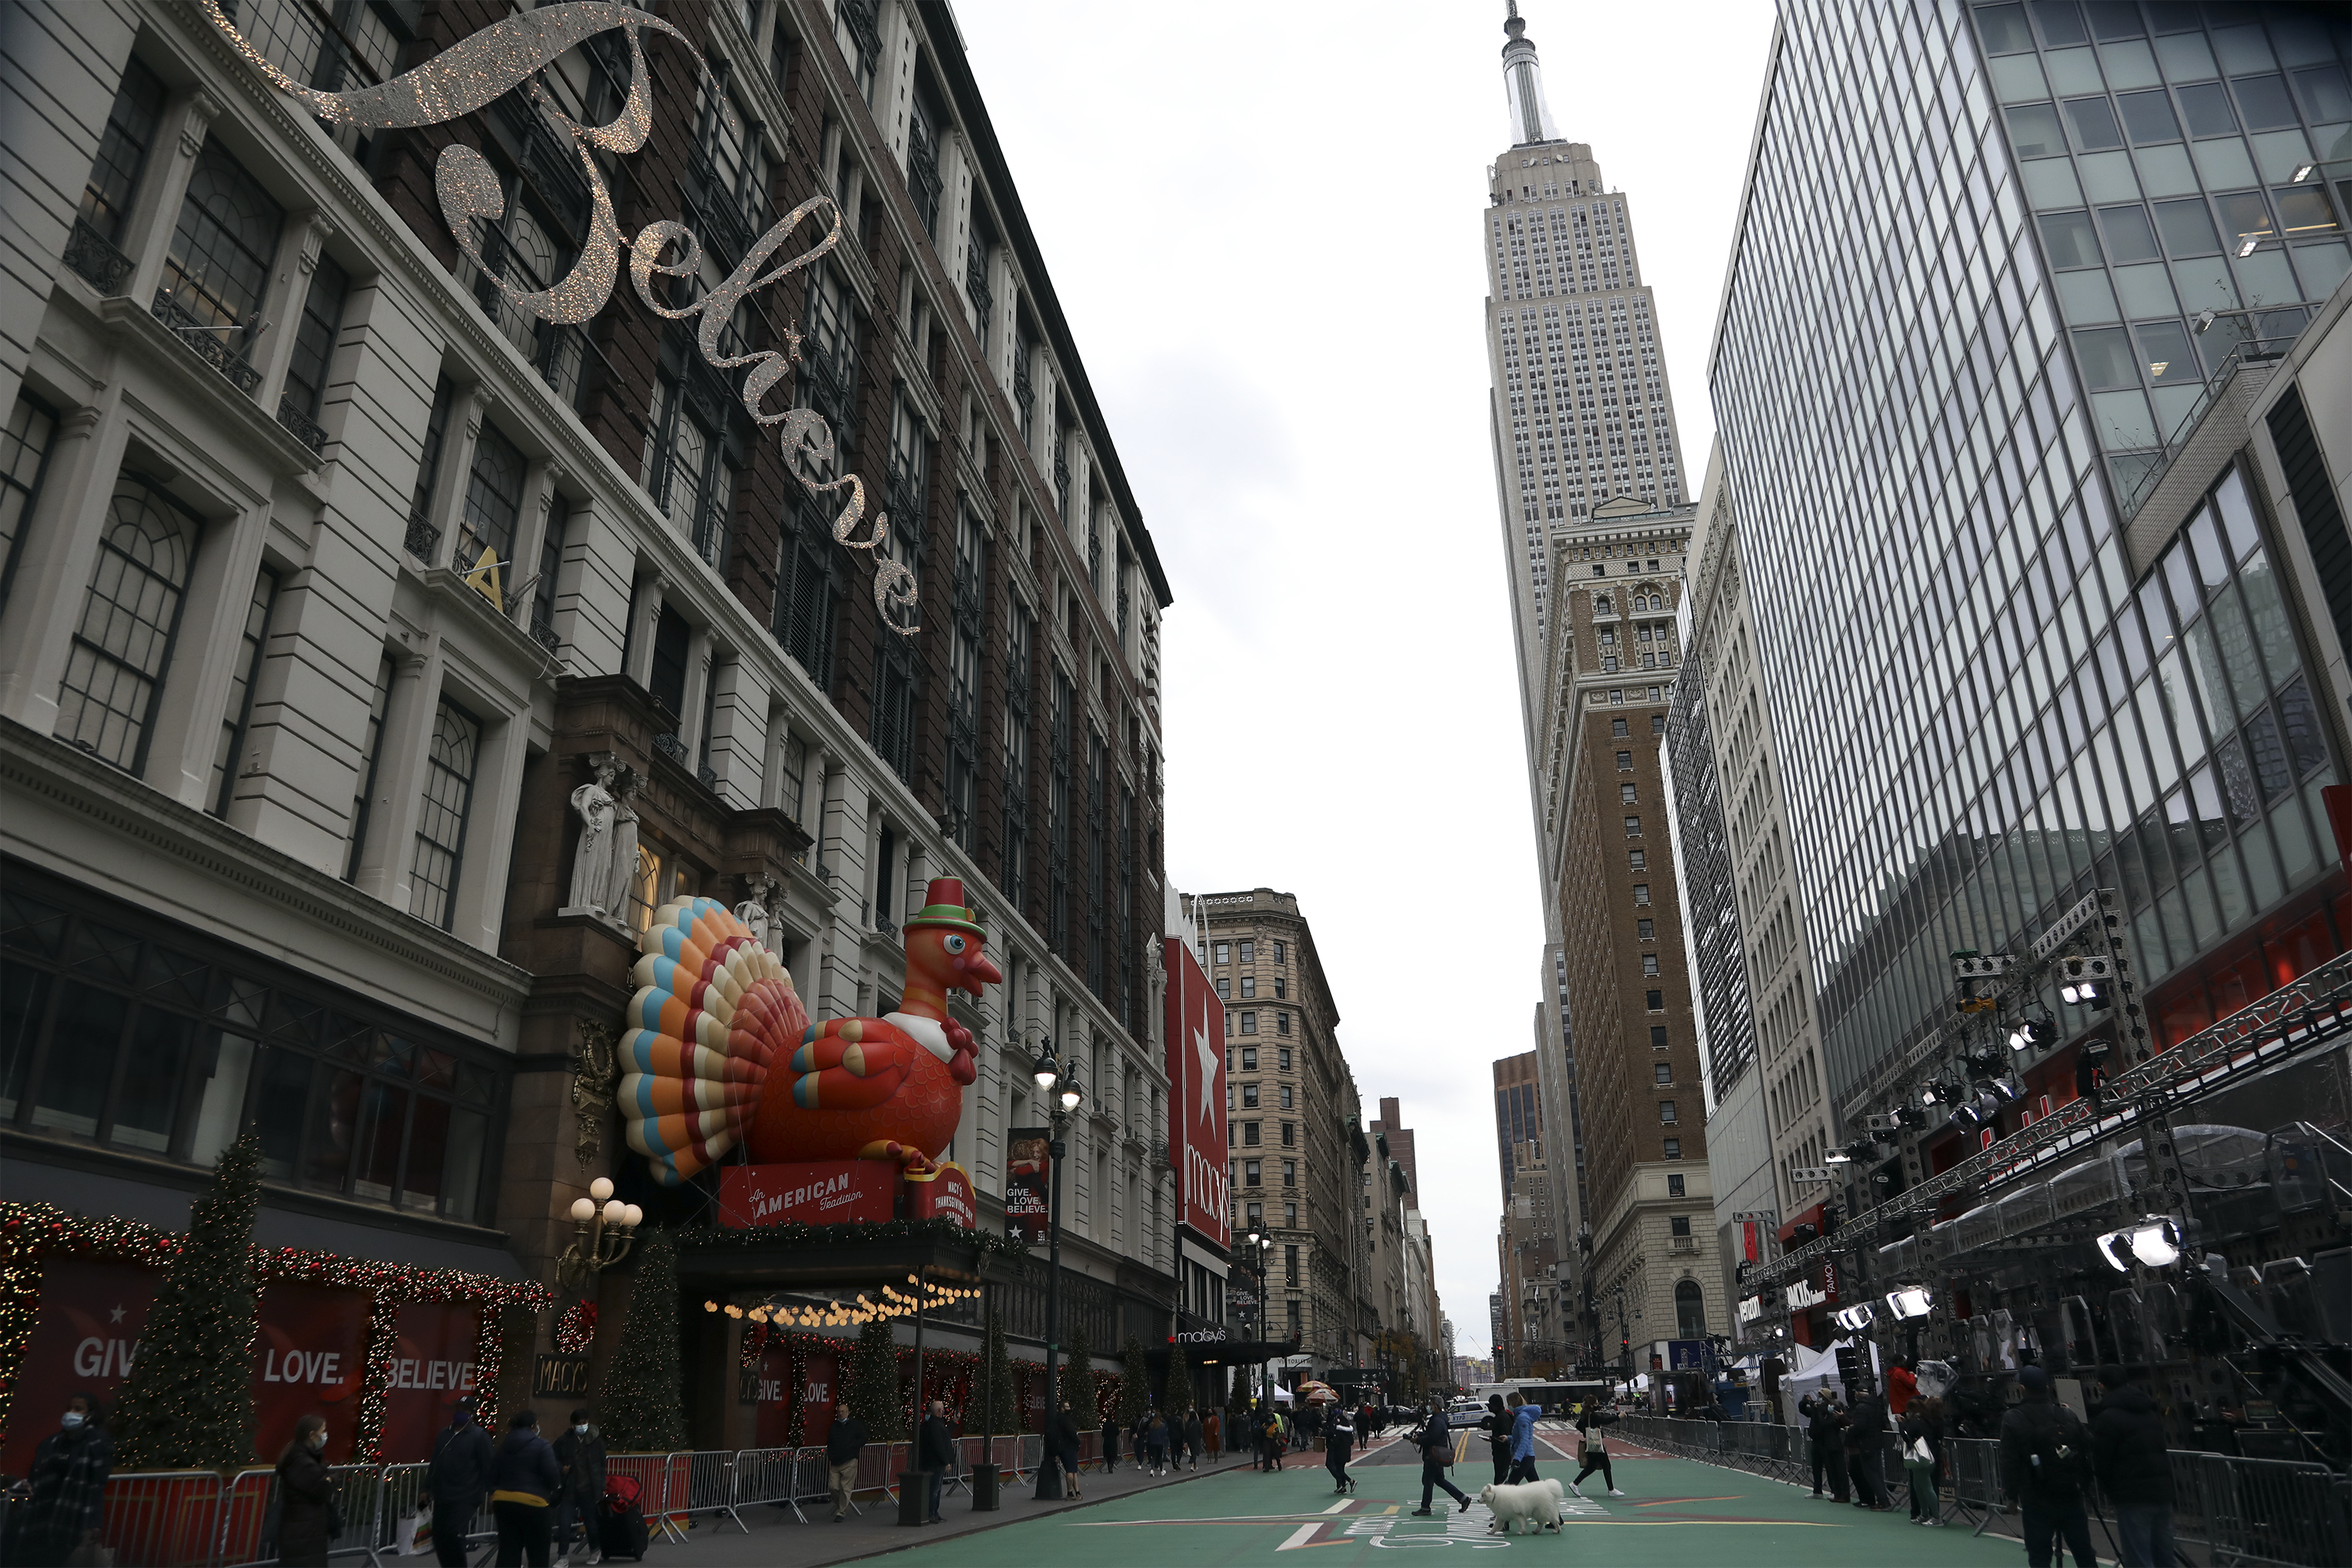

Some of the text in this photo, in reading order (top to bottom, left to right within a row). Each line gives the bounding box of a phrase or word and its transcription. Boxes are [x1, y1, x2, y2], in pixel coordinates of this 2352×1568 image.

[749, 1189, 765, 1203] An
[756, 1172, 848, 1218] AMERICAN
[948, 1181, 963, 1198] MACY'S
[1007, 1188, 1032, 1196] GIVE.
[820, 1191, 863, 1210] Tradition
[935, 1196, 964, 1214] THANKSGIVING
[1007, 1205, 1048, 1214] BELIEVE.
[1738, 1295, 1761, 1323] verizon
[74, 1337, 141, 1377] GIV
[264, 1348, 343, 1385] LOVE.
[540, 1361, 587, 1393] MACY'S
